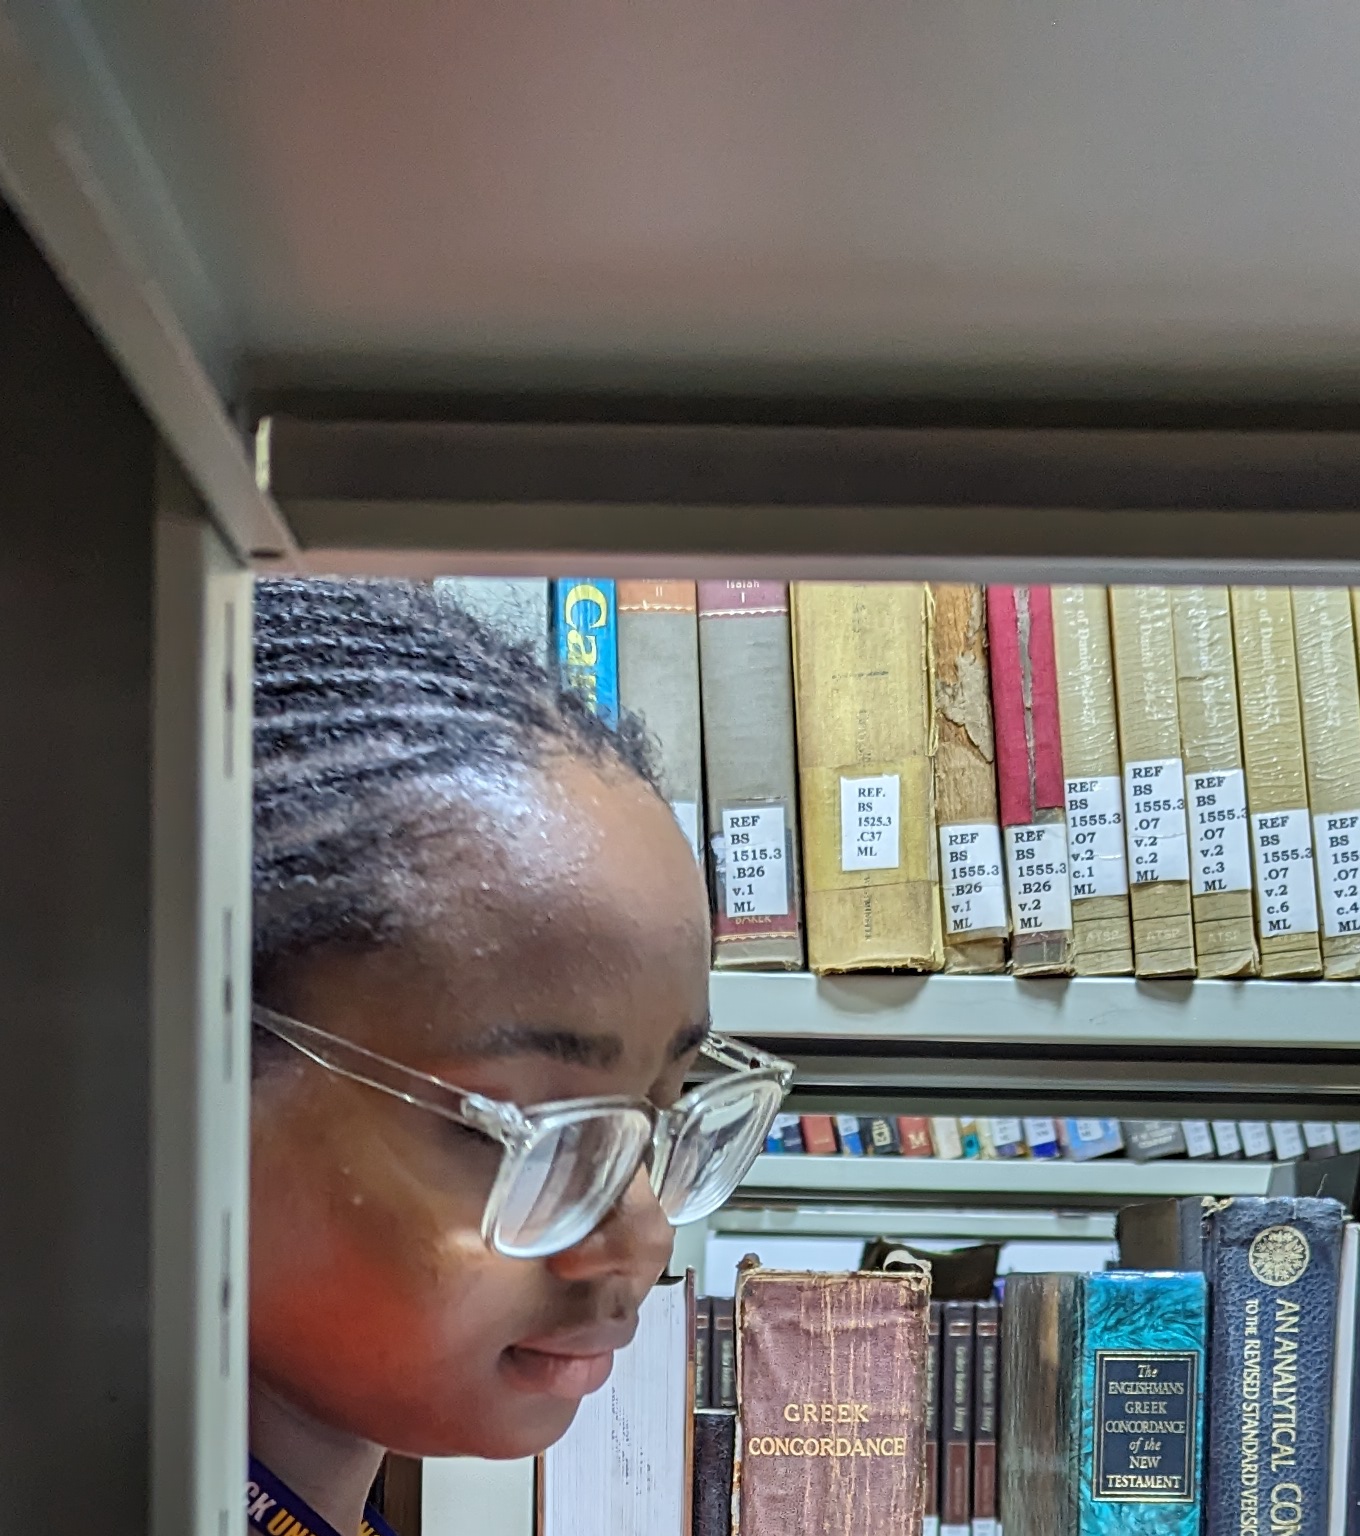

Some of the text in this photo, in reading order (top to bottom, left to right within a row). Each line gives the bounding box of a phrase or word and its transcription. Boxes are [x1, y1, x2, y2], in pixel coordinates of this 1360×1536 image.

[858, 788, 886, 798] REF.
[858, 803, 873, 812] BS
[730, 816, 760, 828] REF
[858, 817, 892, 827] 1525.3
[731, 833, 749, 844] BS
[857, 832, 882, 842] .C37
[1015, 830, 1045, 843] REF
[732, 848, 782, 861] 1515.3
[857, 847, 877, 856] ML
[1016, 849, 1035, 860] BS
[732, 867, 765, 878] .B26
[1018, 863, 1066, 877] 1555.3
[733, 885, 754, 896] v.1
[1018, 882, 1052, 895] .B26
[734, 902, 755, 913] ML
[1018, 900, 1041, 911] v.2
[1020, 918, 1042, 929] ML
[1246, 1299, 1258, 1314] TO
[1275, 1299, 1300, 1332] AN
[1244, 1316, 1258, 1336] THE
[1138, 1364, 1158, 1378] The
[1242, 1340, 1260, 1400] REVISED
[1124, 1401, 1167, 1414] GREEK
[1270, 1336, 1298, 1472] ANALYTICAL
[784, 1404, 869, 1424] GREEK
[1106, 1420, 1185, 1434] CONCORDANCE
[748, 1436, 906, 1456] CONCORDANCE
[1129, 1437, 1162, 1454] of the
[1241, 1402, 1260, 1486] STANDARD
[1129, 1456, 1162, 1468] NEW
[1106, 1475, 1182, 1488] TESTAMENT
[248, 1481, 277, 1522] CK
